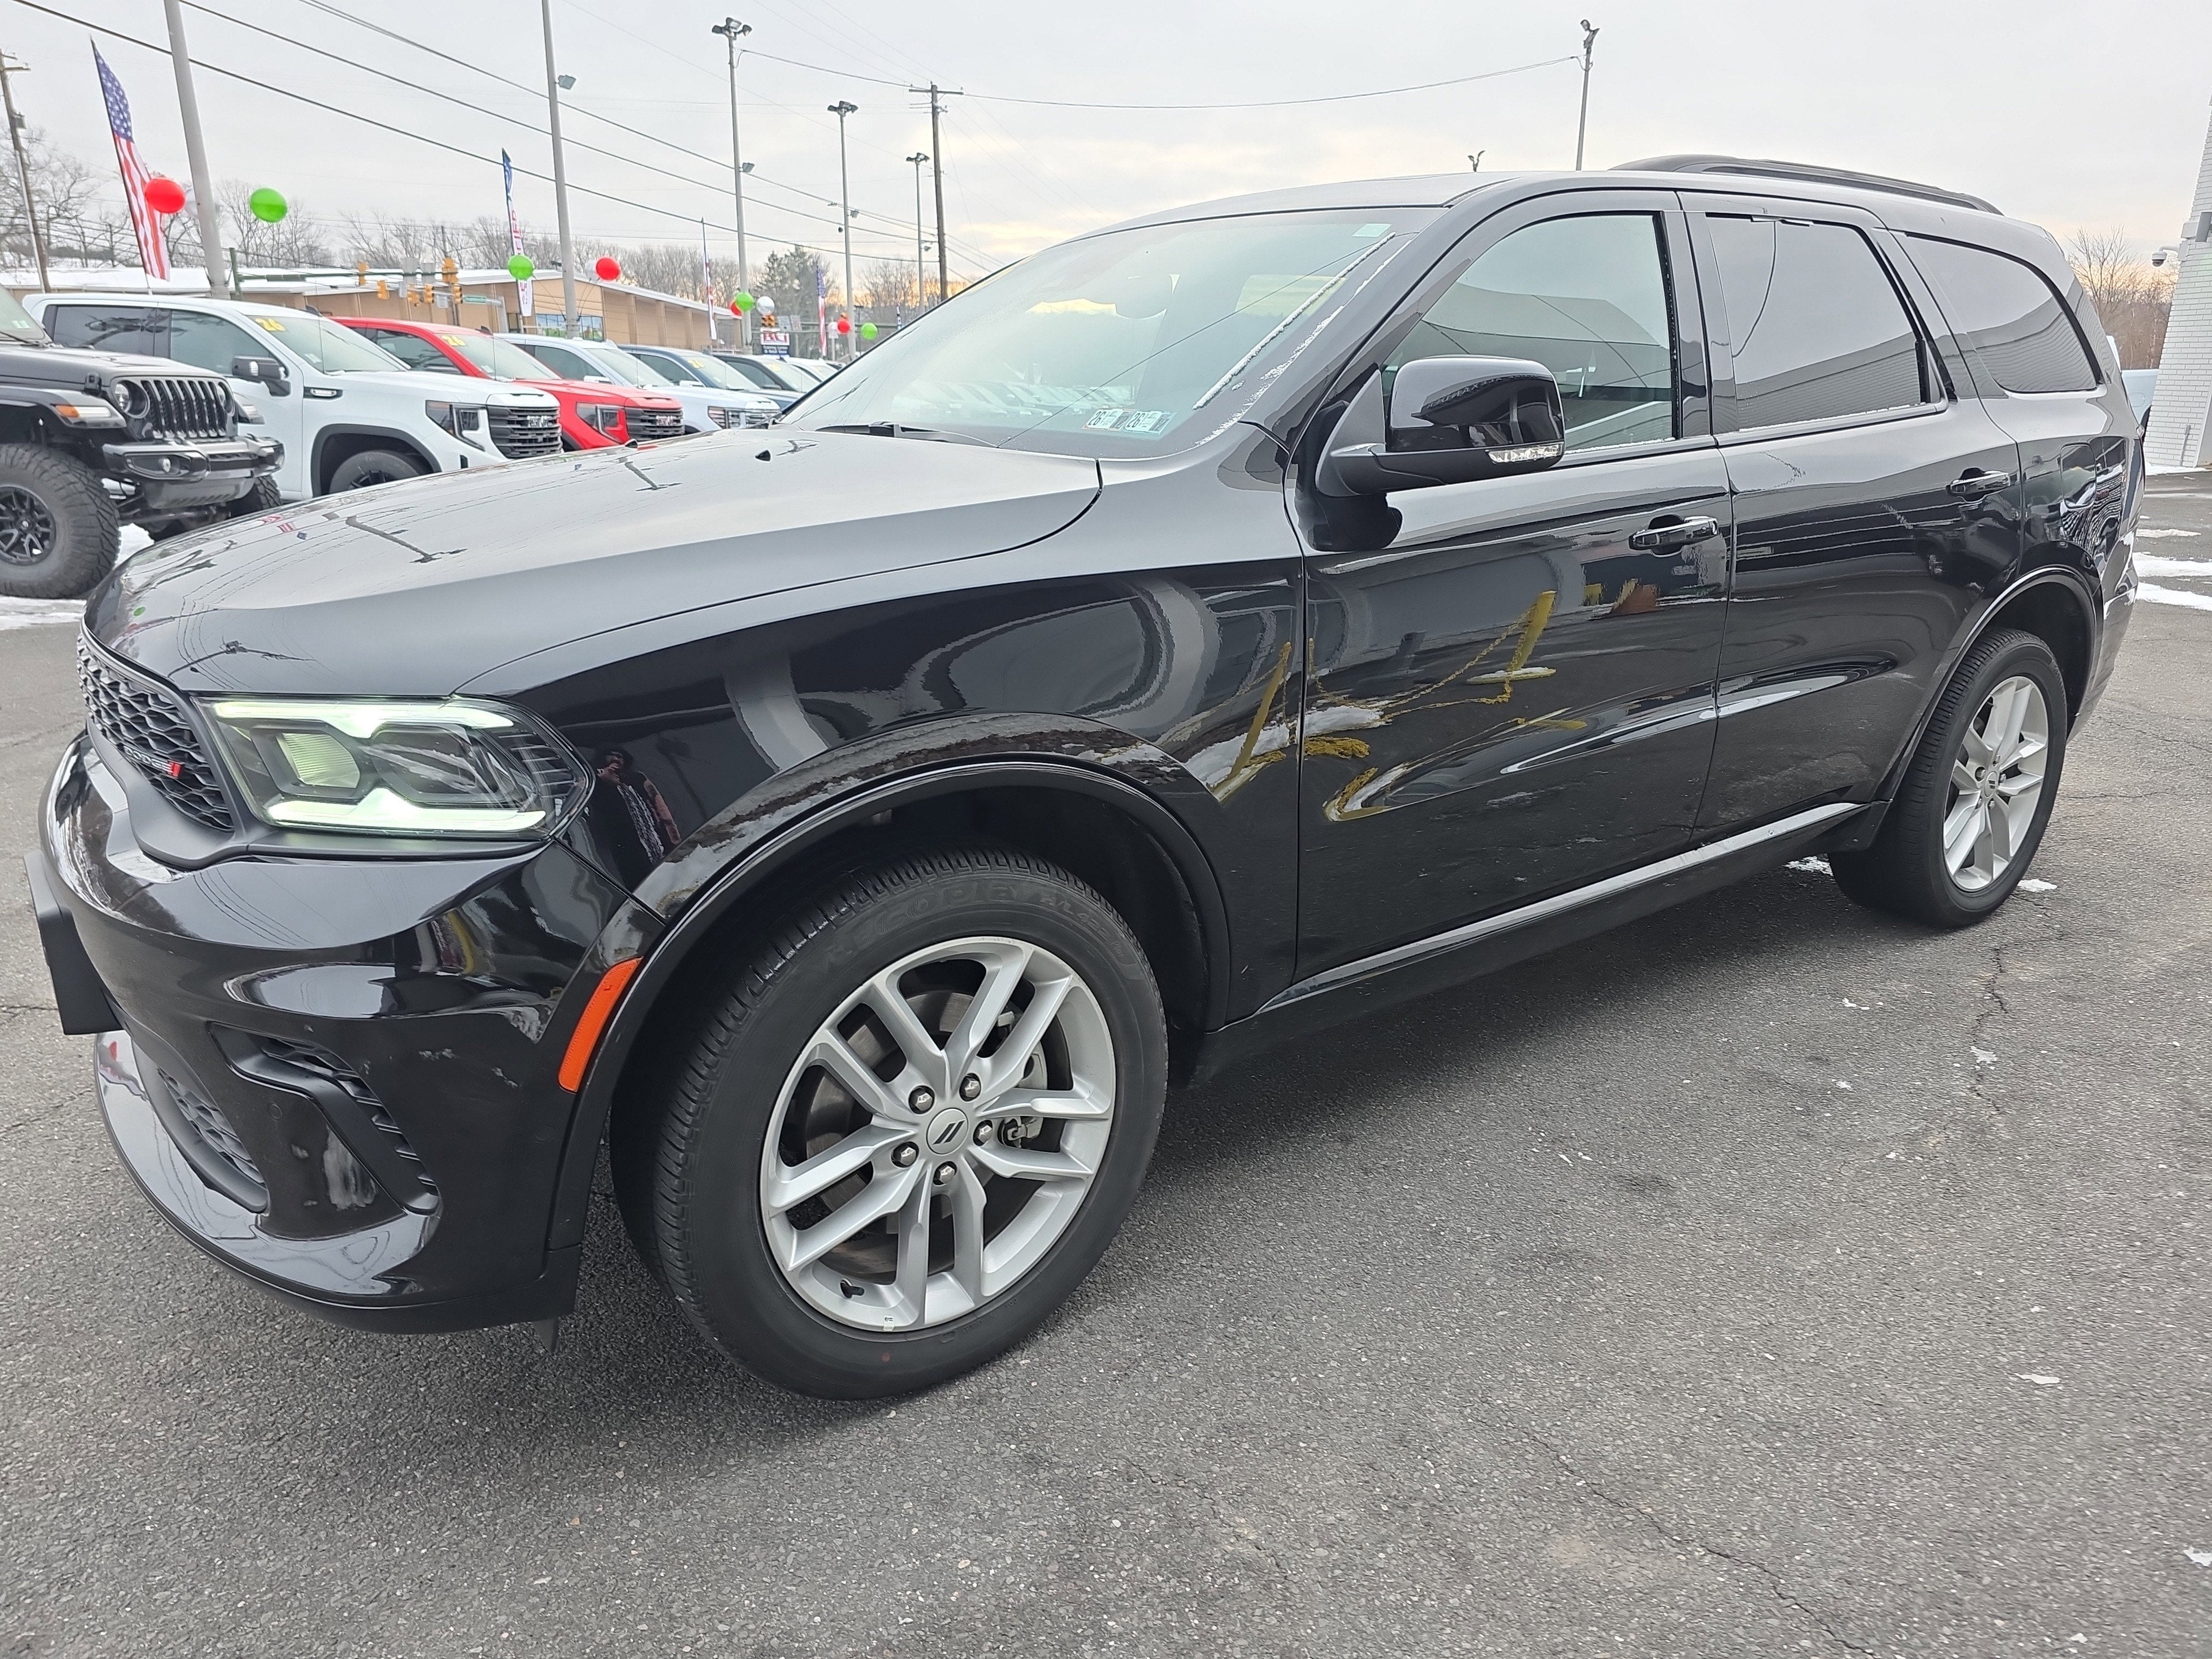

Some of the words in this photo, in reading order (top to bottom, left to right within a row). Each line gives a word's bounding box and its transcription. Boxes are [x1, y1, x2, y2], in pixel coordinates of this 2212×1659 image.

[1088, 411, 1107, 426] 26
[1126, 413, 1146, 428] 26
[123, 745, 172, 774] DODGE
